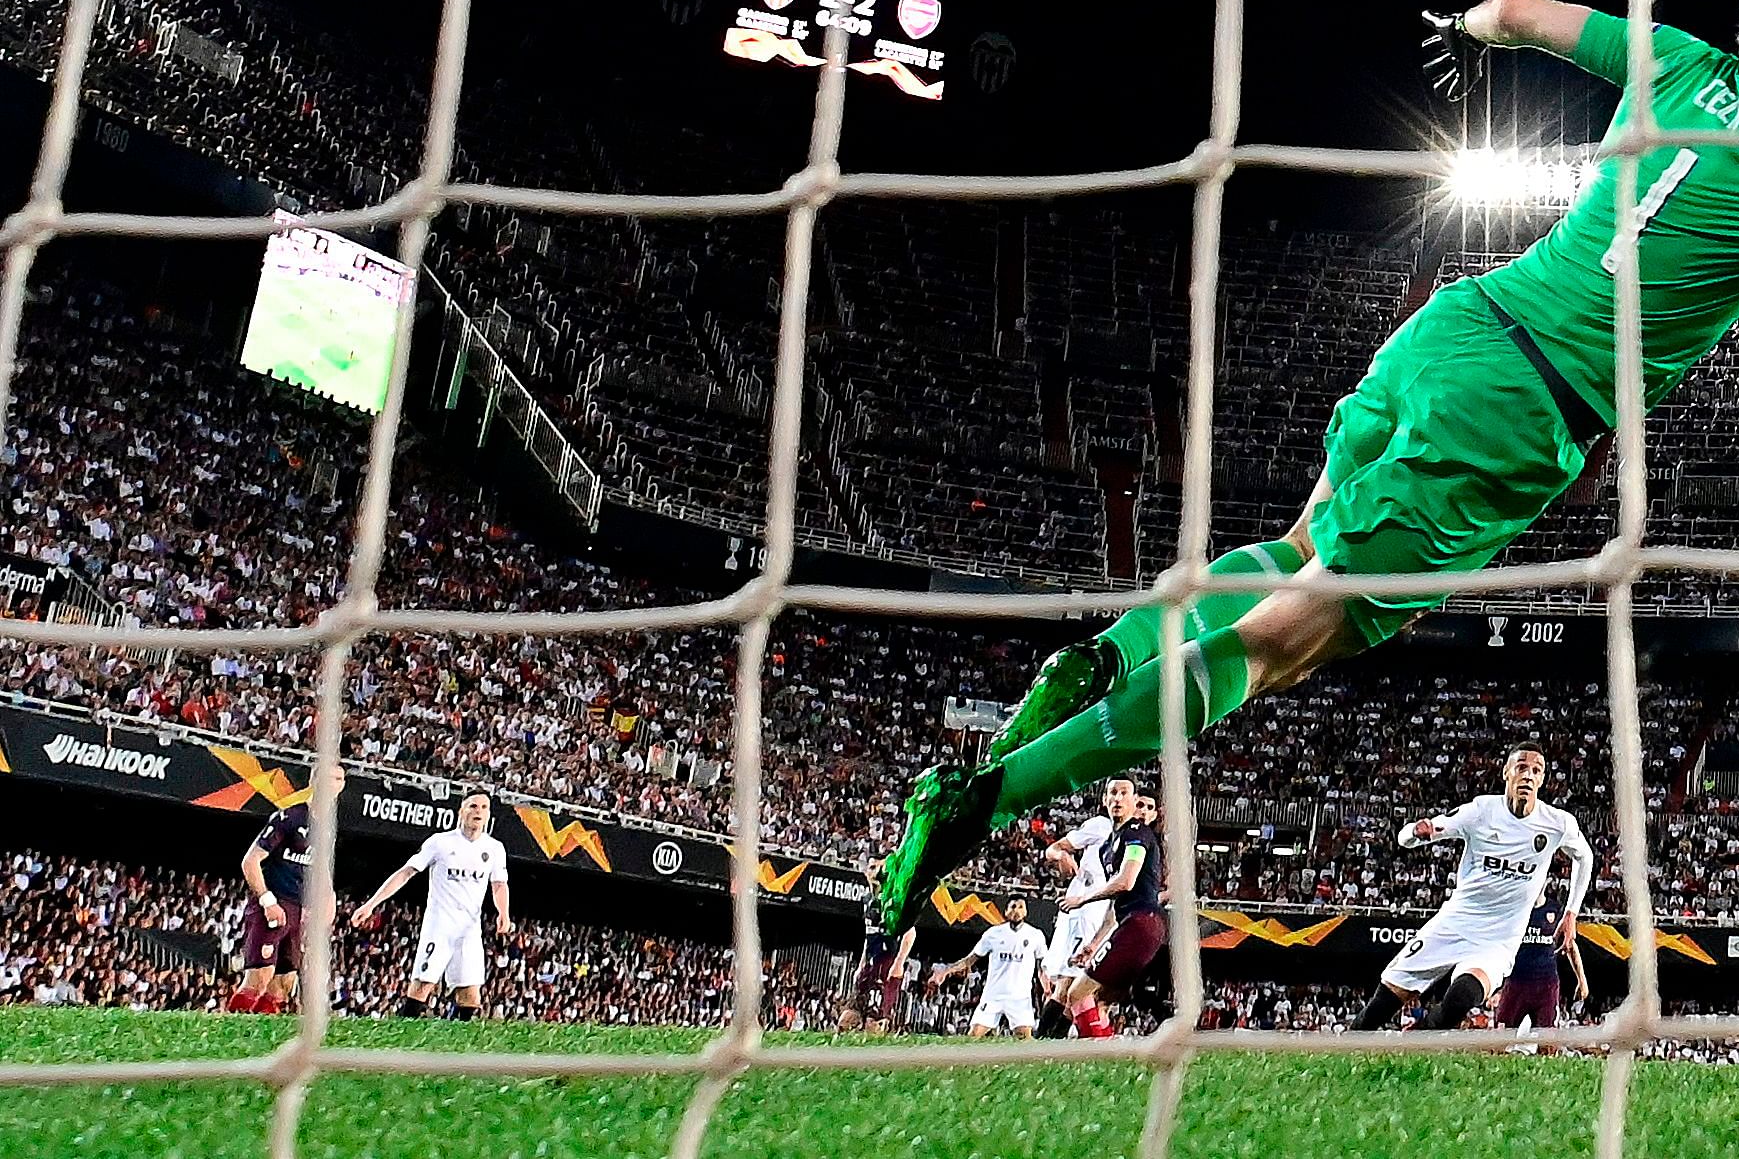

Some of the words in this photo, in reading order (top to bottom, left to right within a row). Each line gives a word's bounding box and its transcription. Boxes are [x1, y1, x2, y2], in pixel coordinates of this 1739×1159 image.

[1520, 622, 1564, 643] 2002
[362, 793, 434, 827] TOGETHER
[436, 807, 454, 830] TO
[1483, 855, 1538, 875] BLU
[808, 875, 834, 897] UEFA
[1369, 926, 1418, 944] TOGE
[424, 941, 436, 959] 9
[1404, 940, 1424, 959] 9
